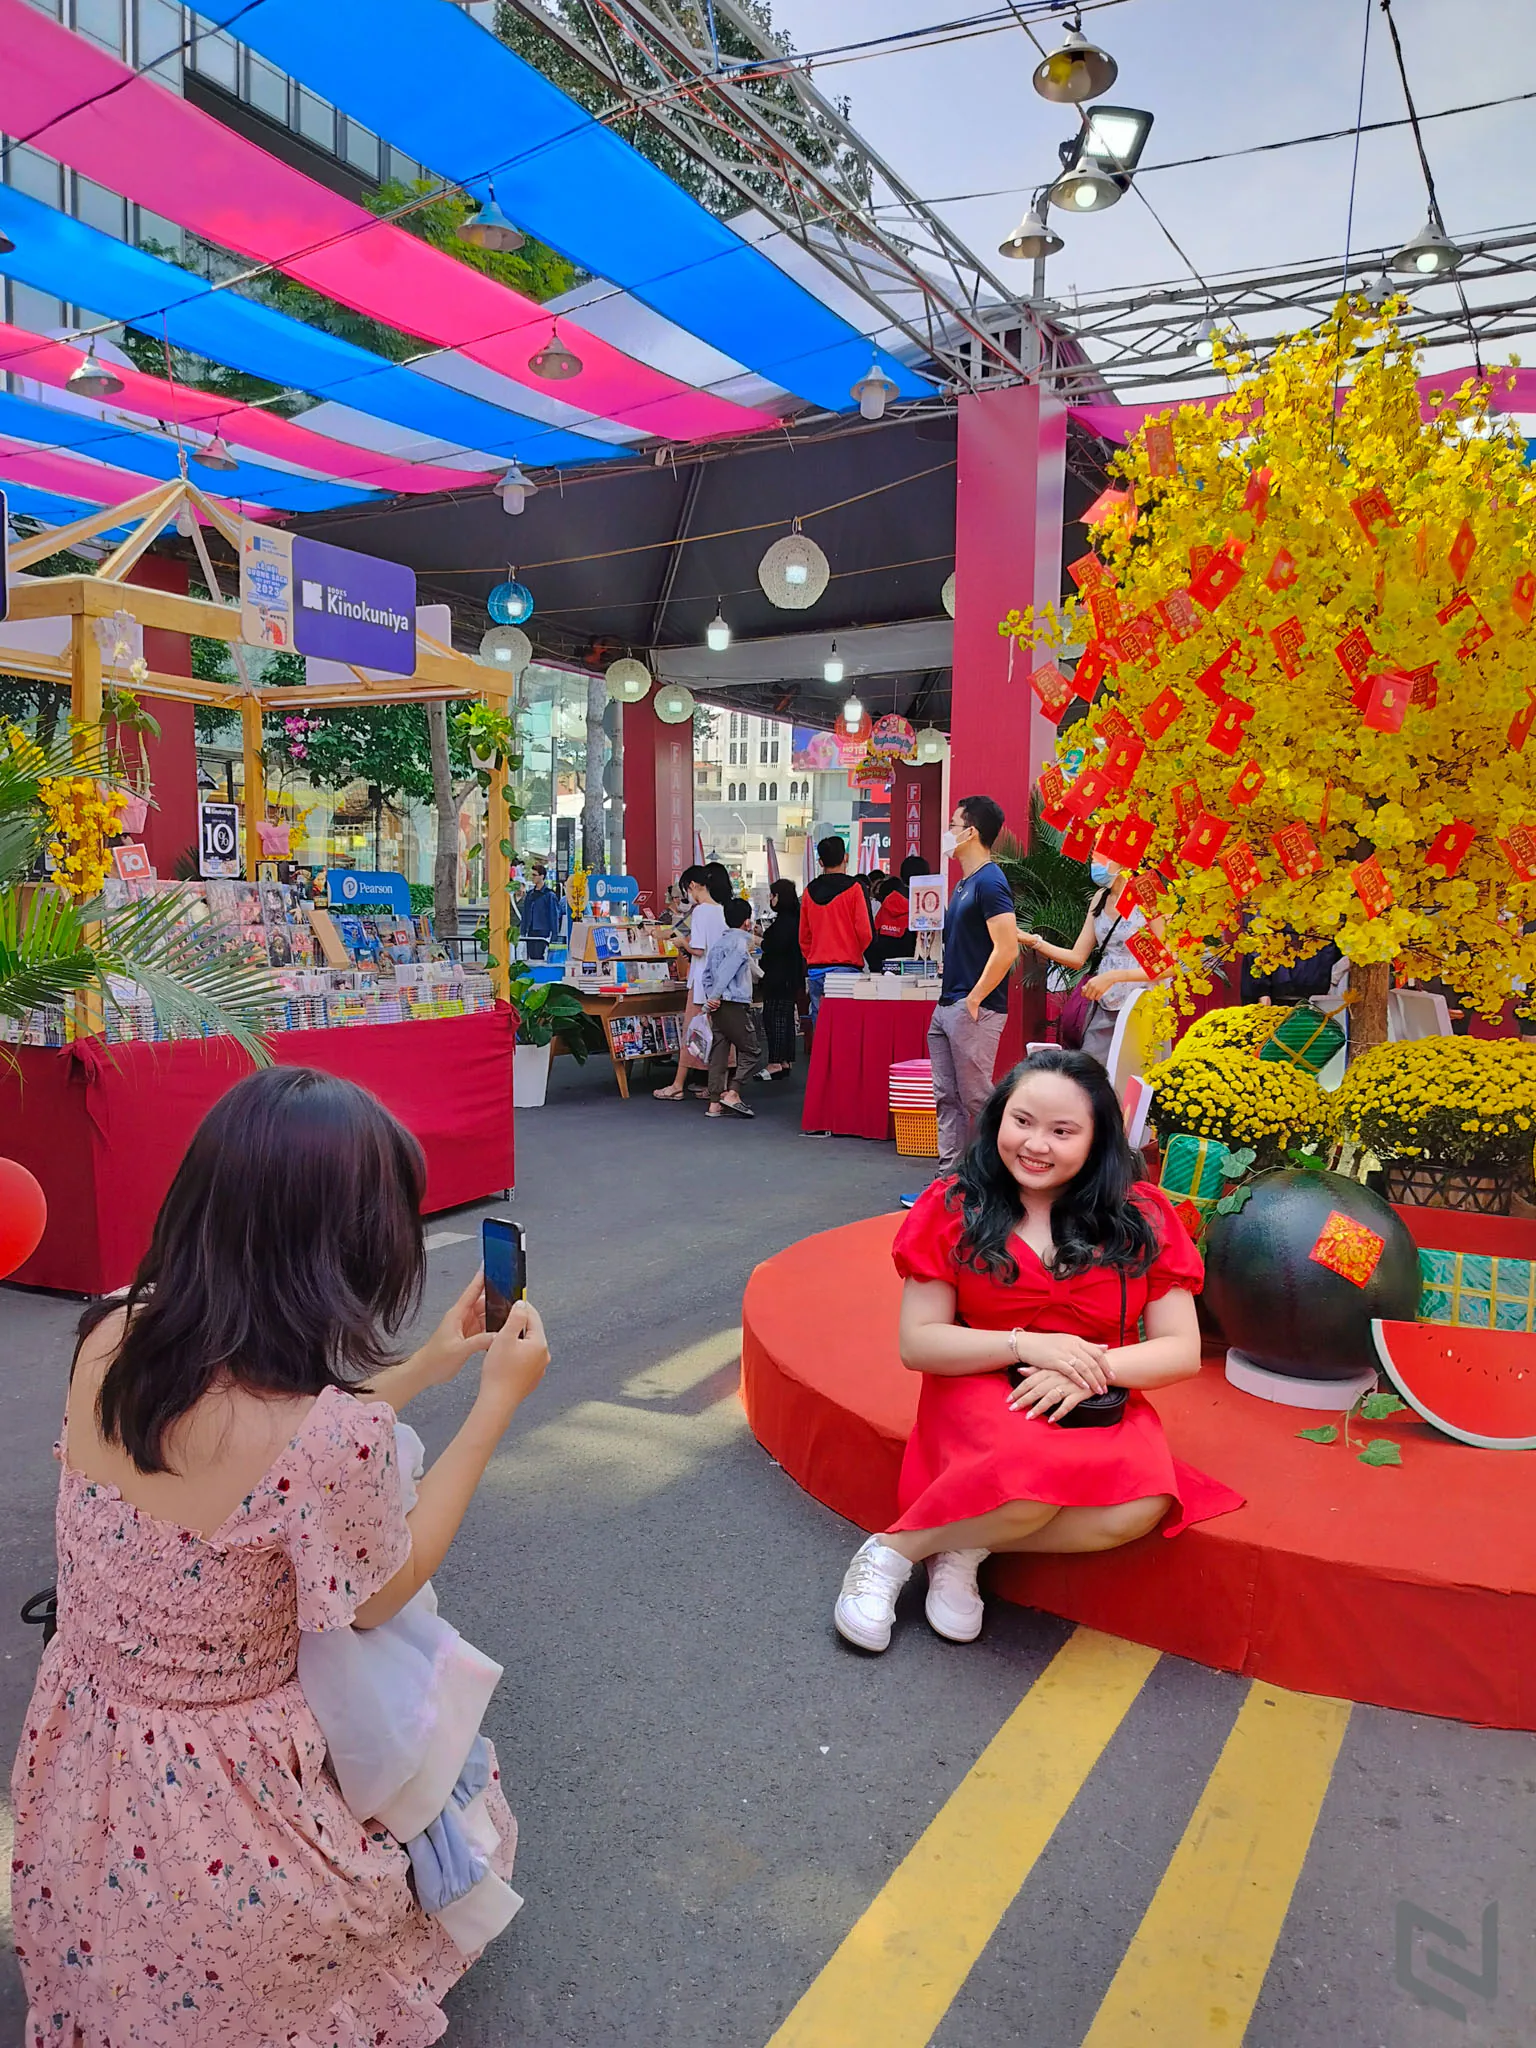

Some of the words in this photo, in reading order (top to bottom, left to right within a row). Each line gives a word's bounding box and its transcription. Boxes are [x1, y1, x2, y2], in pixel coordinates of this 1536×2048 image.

[256, 582, 280, 597] 2023
[327, 586, 348, 598] BOOKS
[327, 593, 409, 634] Kinokuniya
[359, 882, 393, 894] Pearson
[606, 884, 629, 894] Pearson
